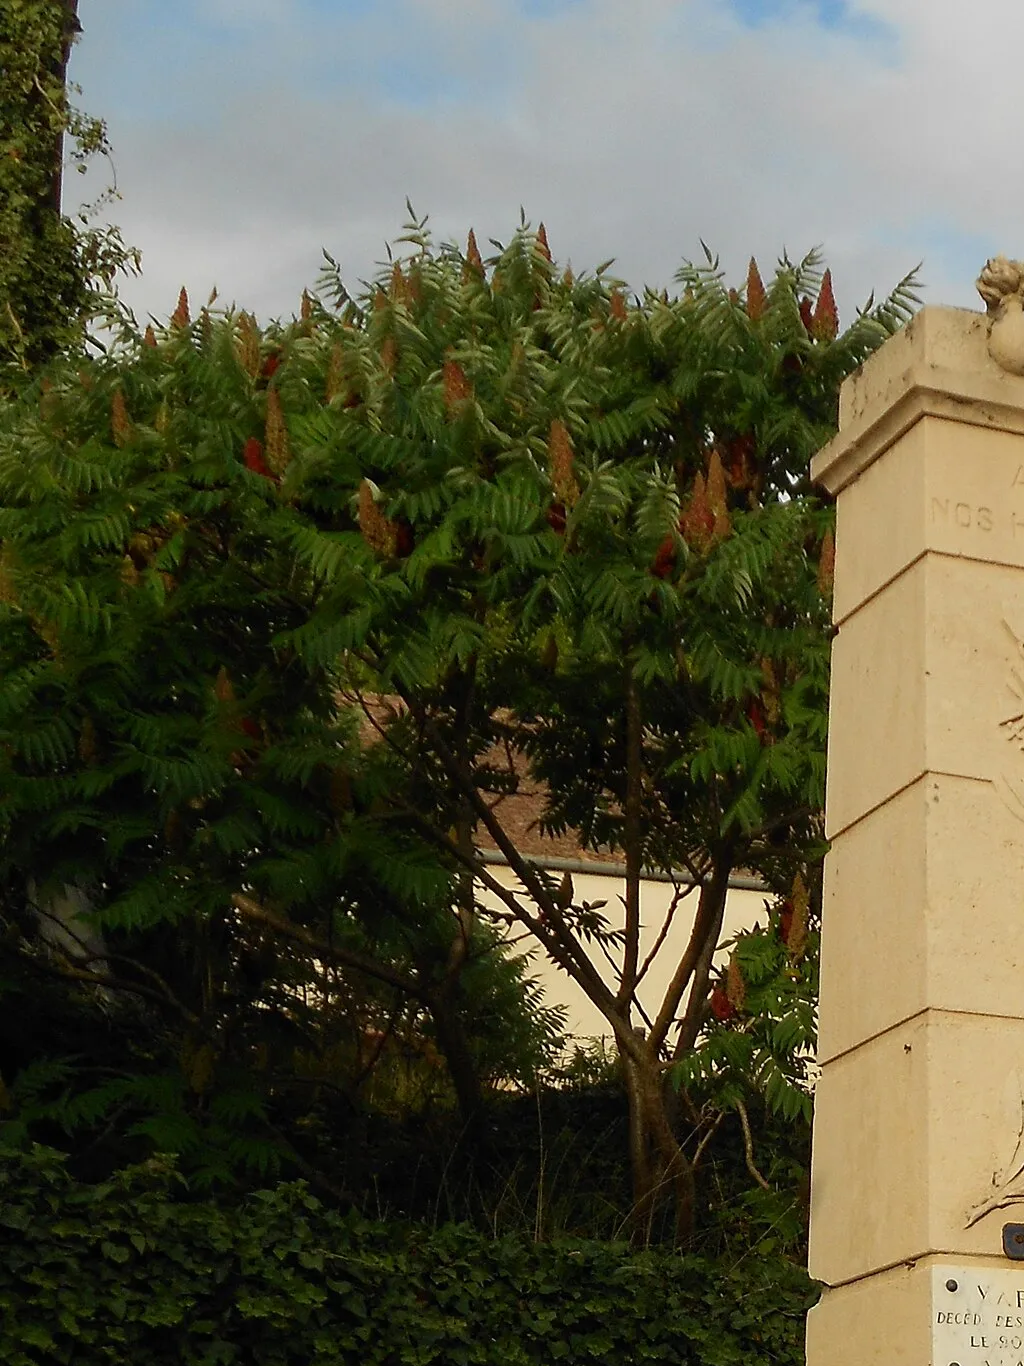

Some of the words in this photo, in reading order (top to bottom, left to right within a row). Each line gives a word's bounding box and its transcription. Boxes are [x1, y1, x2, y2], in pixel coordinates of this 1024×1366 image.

[931, 497, 993, 532] NOS
[937, 1312, 988, 1326] DECED
[970, 1336, 989, 1348] LE
